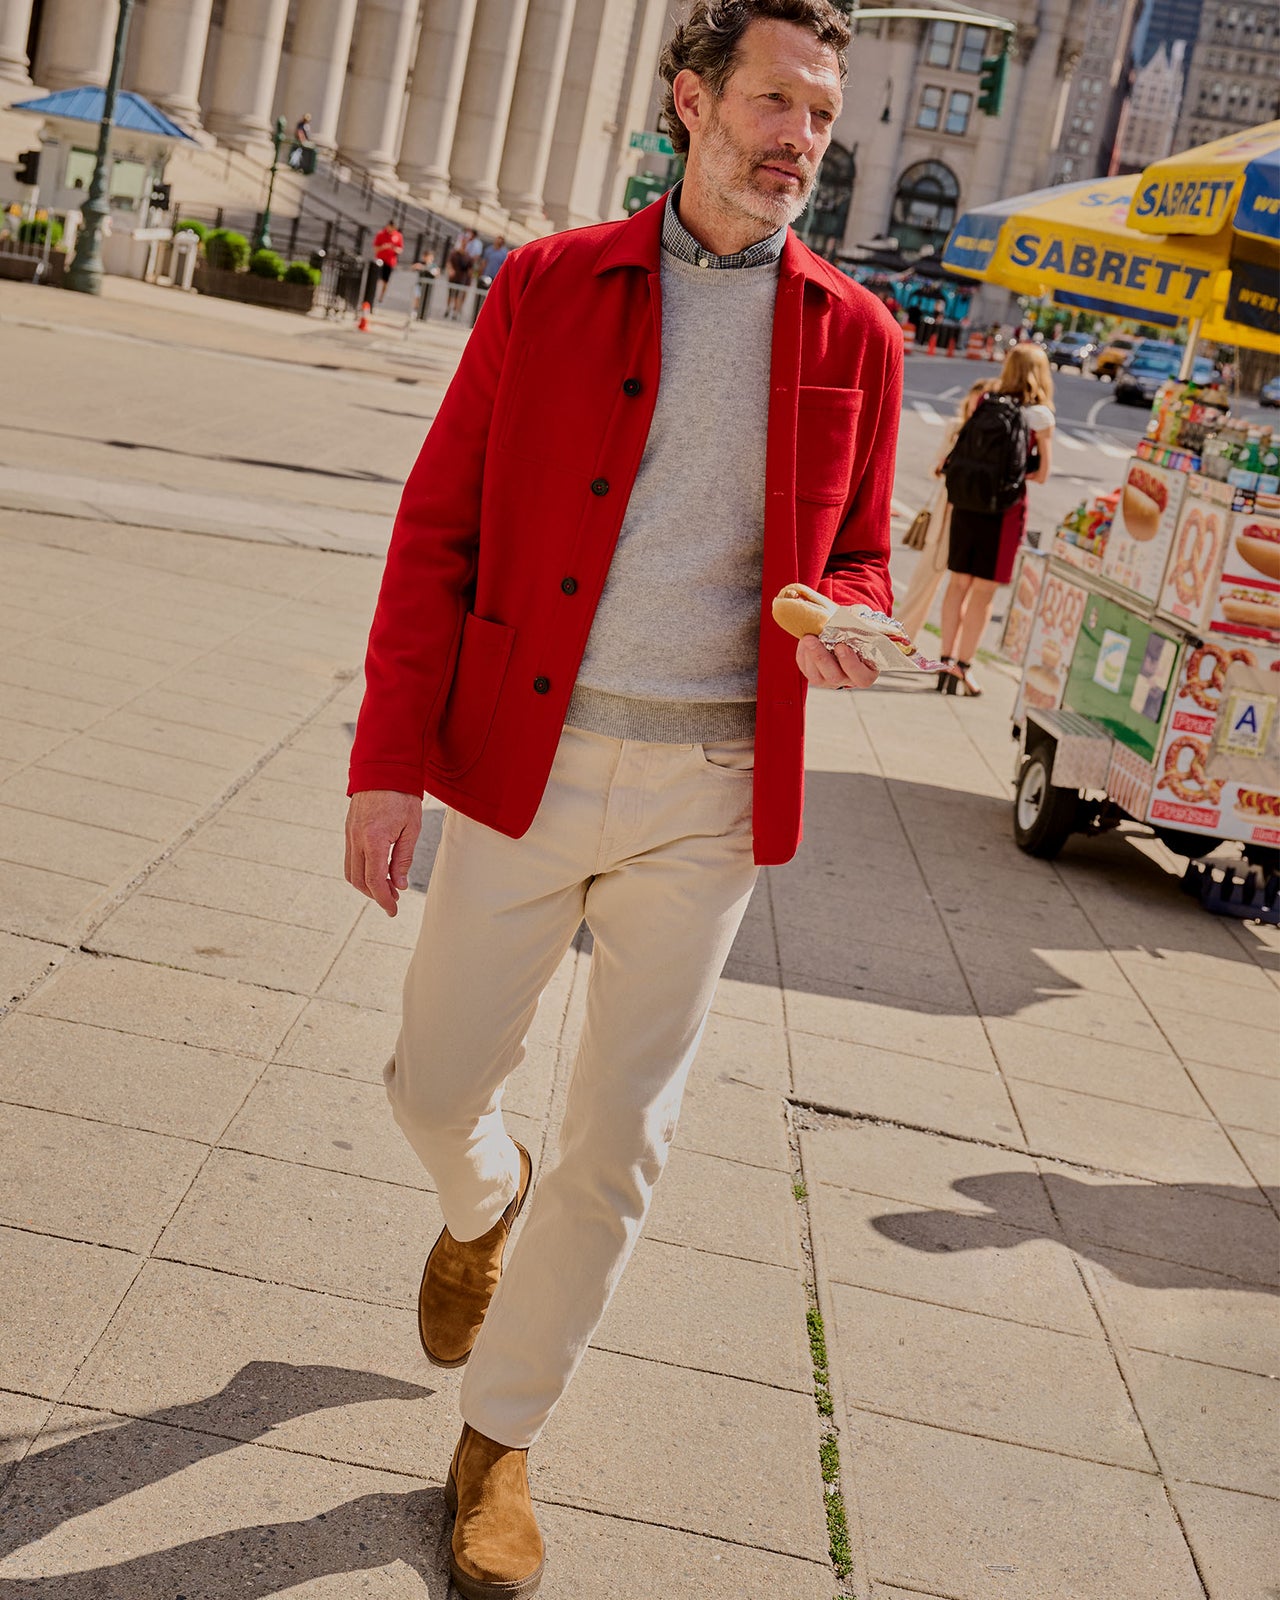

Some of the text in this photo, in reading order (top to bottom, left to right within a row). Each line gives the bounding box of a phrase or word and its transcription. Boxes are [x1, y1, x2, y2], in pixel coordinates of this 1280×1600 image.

[1136, 181, 1236, 217] SABRETT
[1010, 234, 1210, 300] SABRETT
[1234, 704, 1257, 733] A
